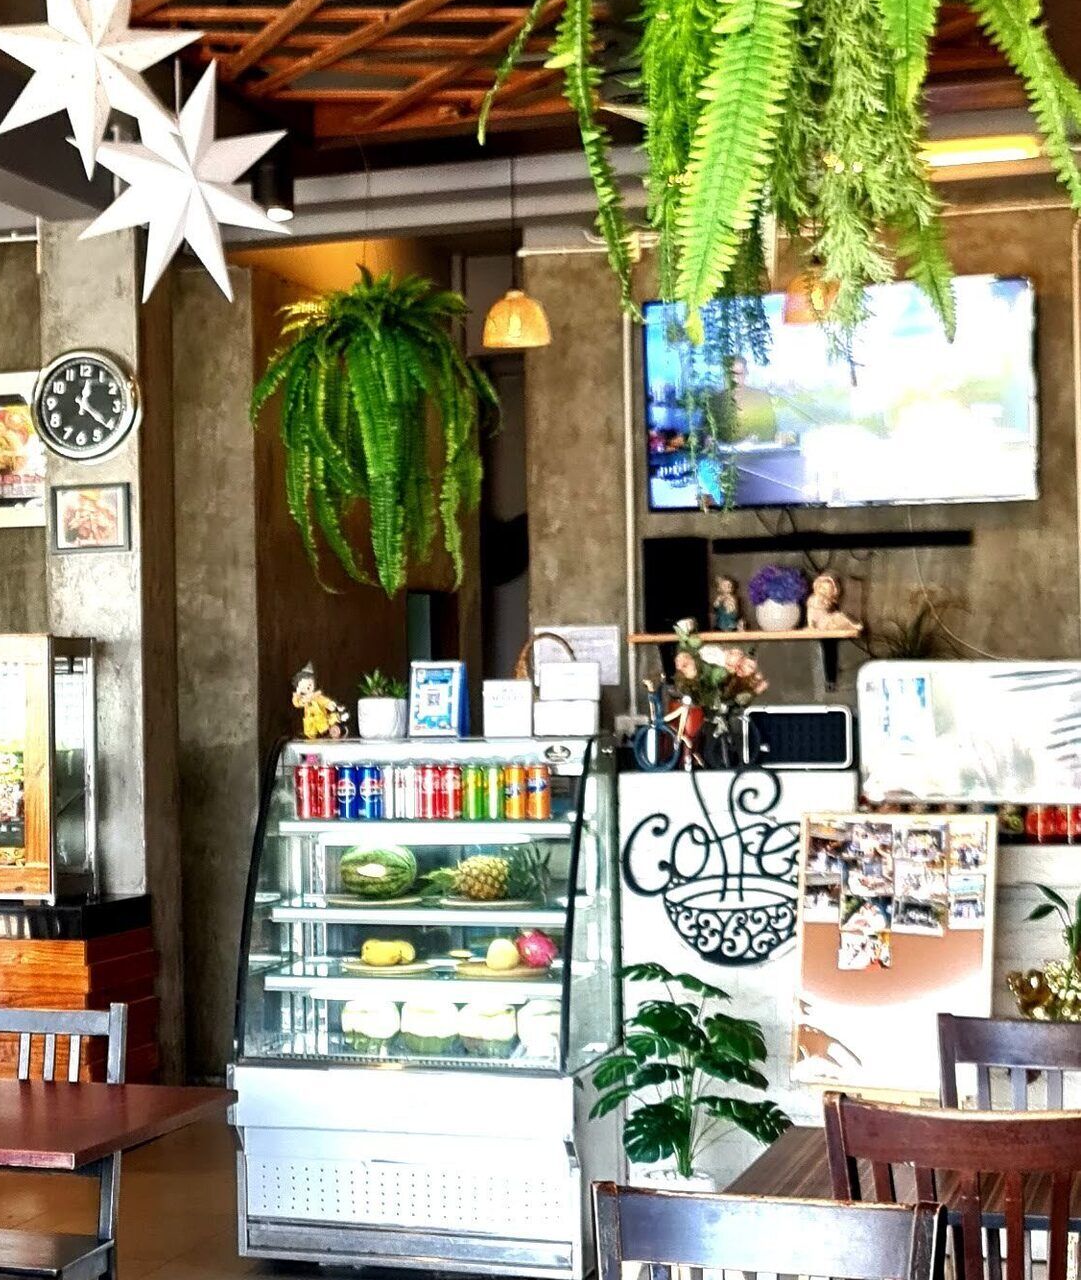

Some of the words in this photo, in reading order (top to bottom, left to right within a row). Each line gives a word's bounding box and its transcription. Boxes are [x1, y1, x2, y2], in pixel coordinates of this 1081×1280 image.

[66, 369, 74, 381] 11
[80, 365, 91, 377] 12
[99, 371, 104, 383] 1
[53, 381, 65, 394] 10
[108, 382, 117, 395] 2
[47, 397, 56, 411] 9
[112, 400, 121, 413] 3
[50, 413, 60, 428] 8
[63, 426, 73, 440] 7
[76, 431, 86, 446] 6
